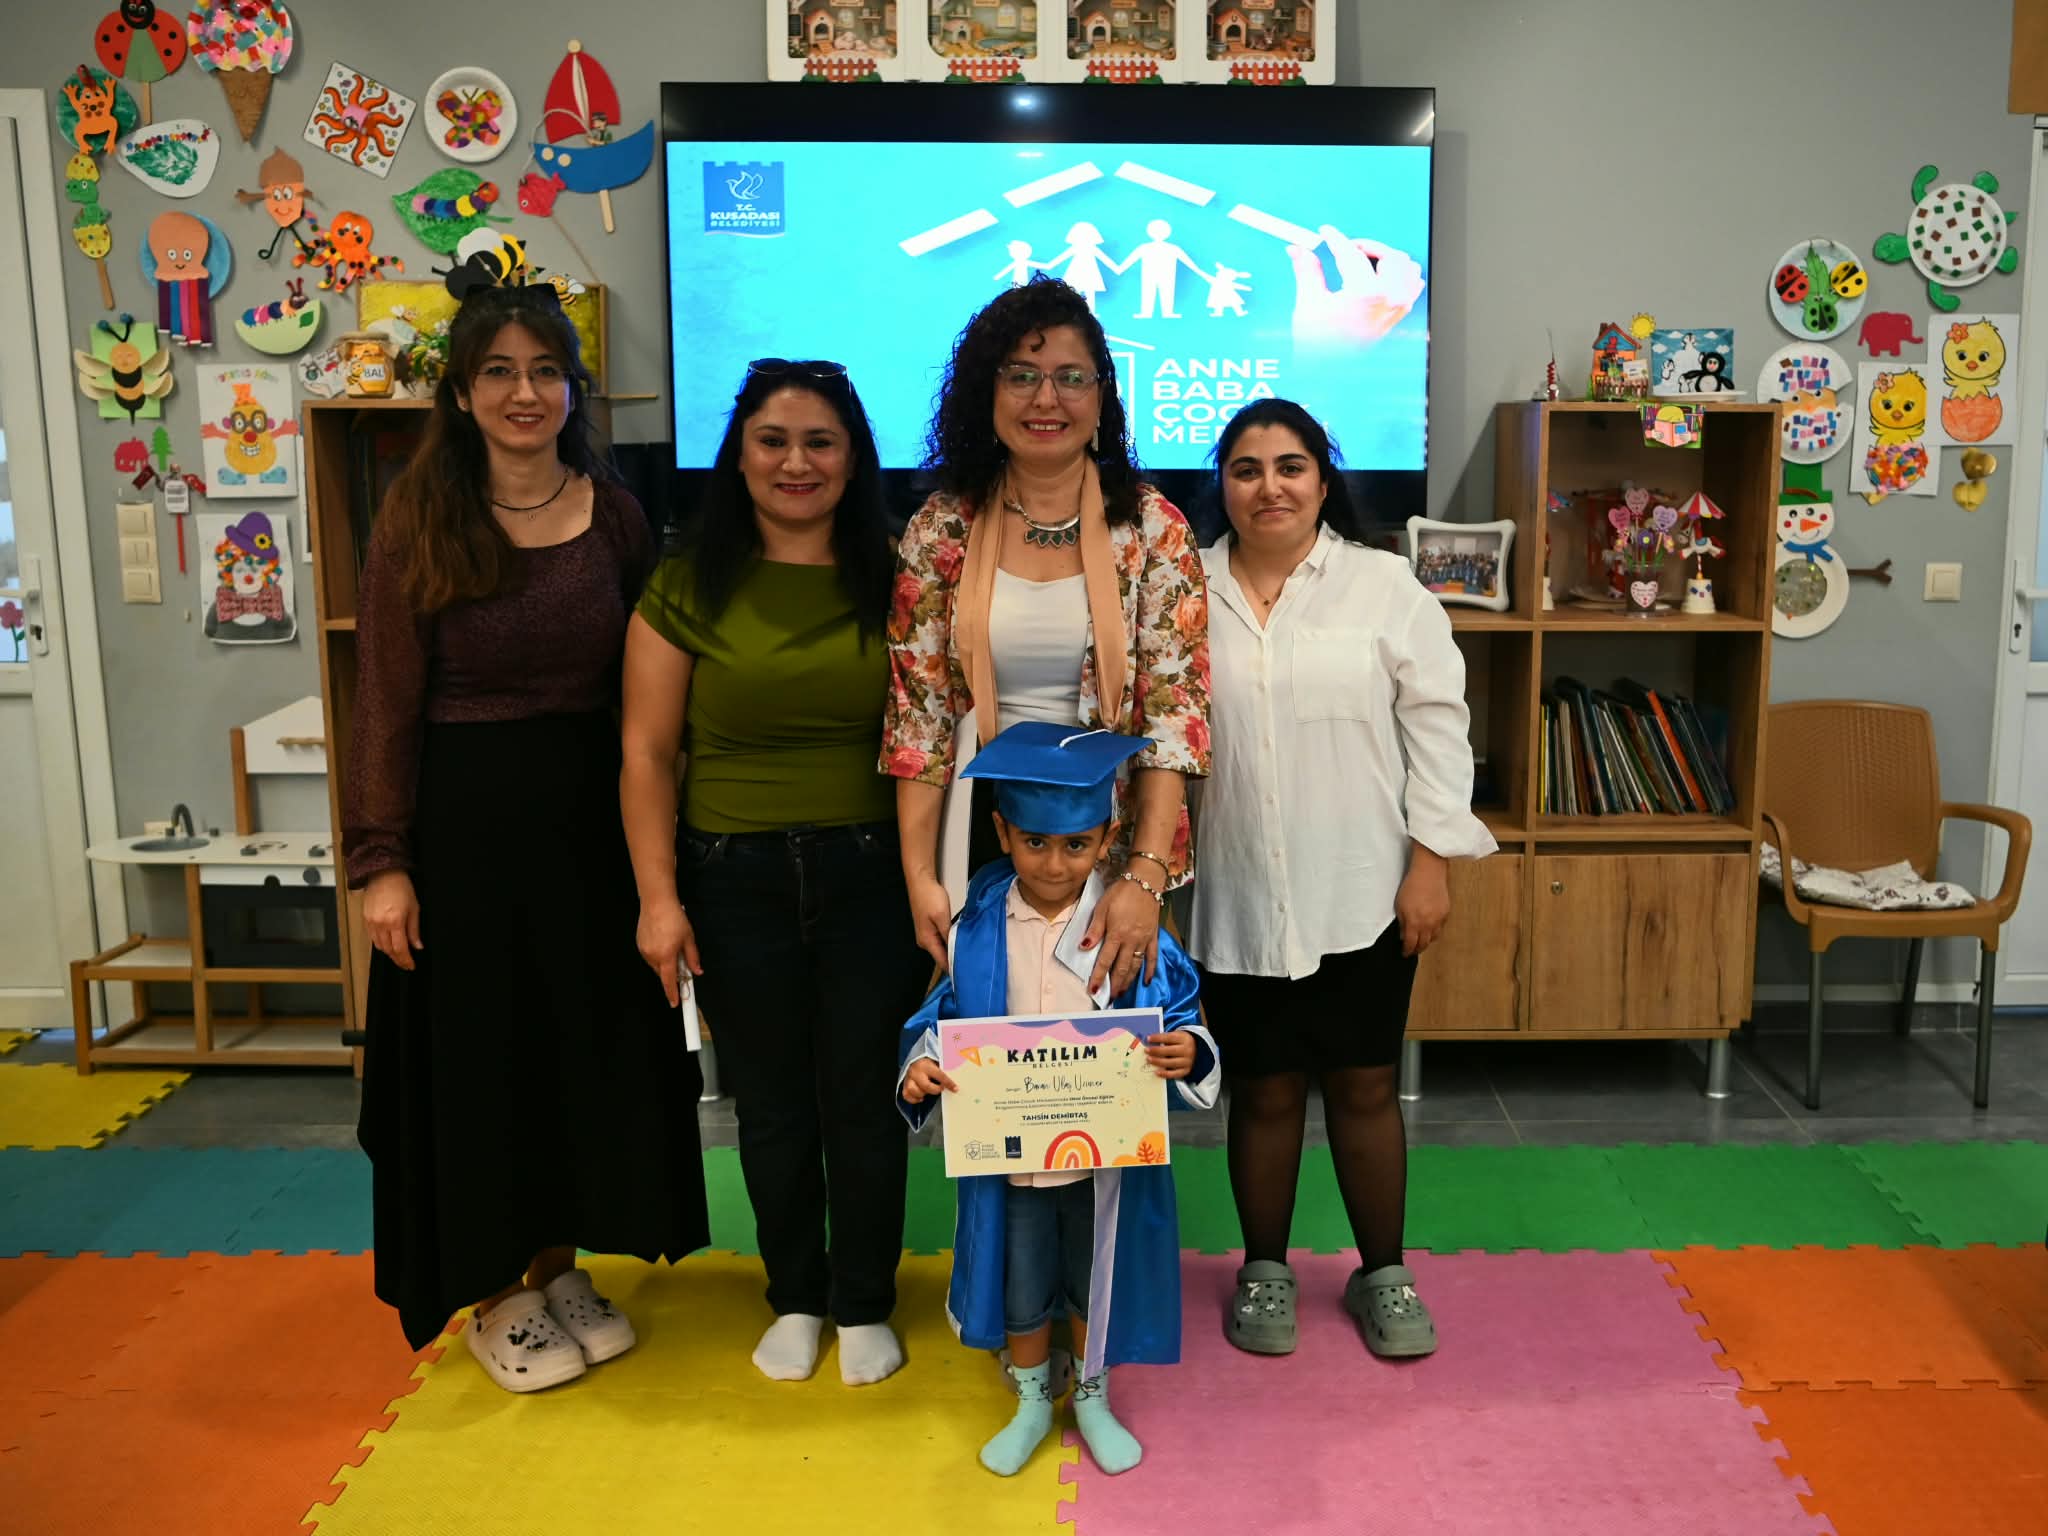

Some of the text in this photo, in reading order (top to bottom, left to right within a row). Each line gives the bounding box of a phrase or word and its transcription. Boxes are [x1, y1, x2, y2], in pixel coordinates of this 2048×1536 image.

[1154, 358, 1281, 379] ANNE
[1152, 381, 1276, 401] BABA
[1007, 1045, 1098, 1064] KATILIM
